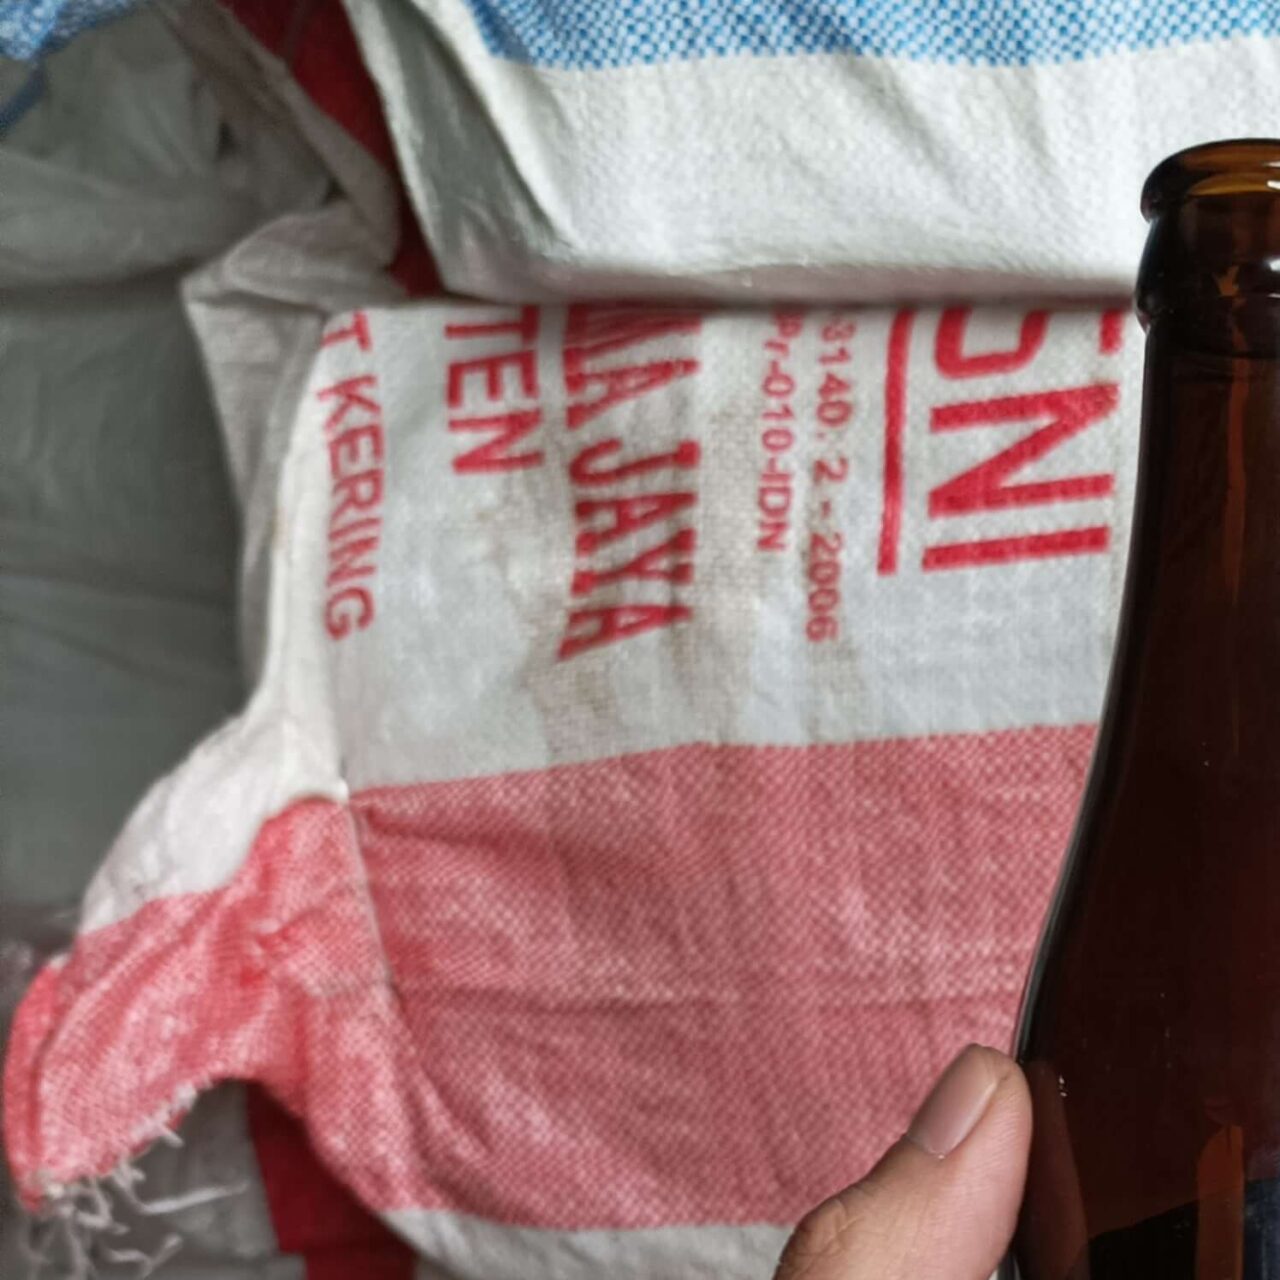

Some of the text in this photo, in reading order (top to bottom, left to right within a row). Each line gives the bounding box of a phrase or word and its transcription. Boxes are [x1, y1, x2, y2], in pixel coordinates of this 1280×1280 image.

[317, 375, 384, 641] KERING
[556, 439, 702, 662] JAYA
[756, 305, 803, 553] Pr-010-IDN
[920, 305, 1126, 573] SNI
[805, 531, 843, 643] 2006
